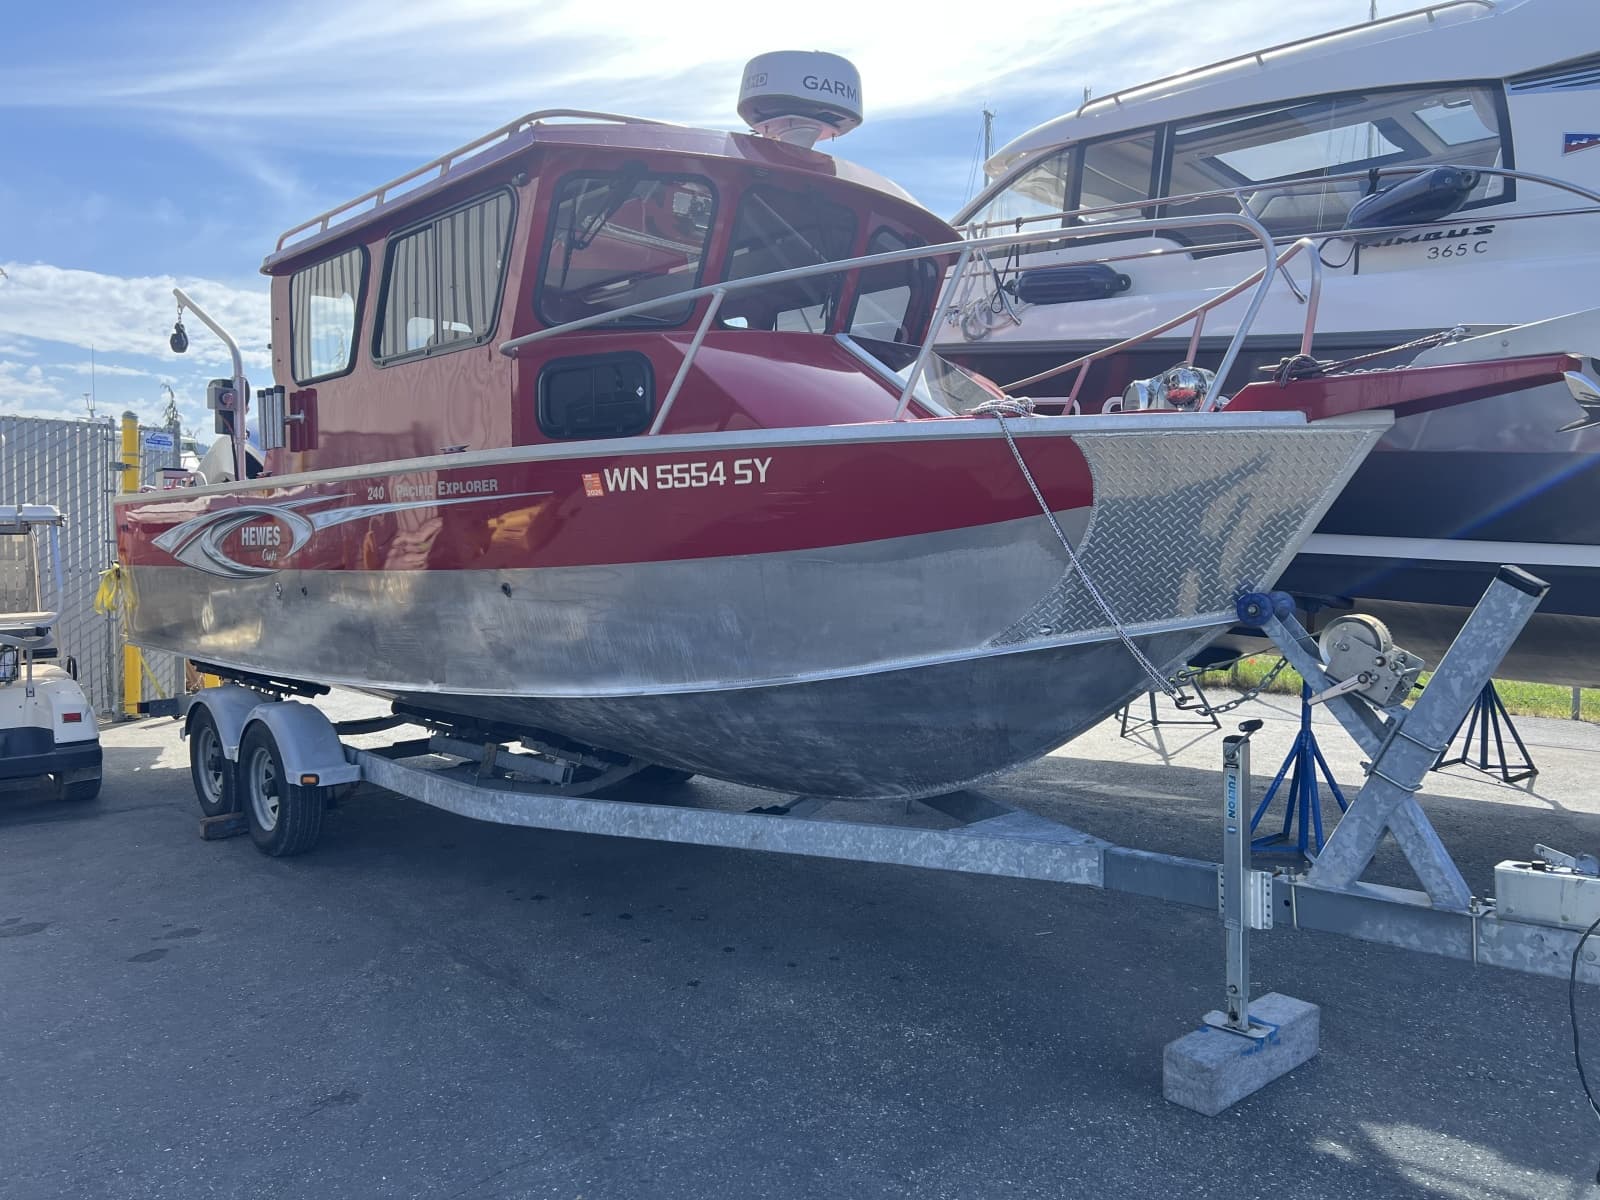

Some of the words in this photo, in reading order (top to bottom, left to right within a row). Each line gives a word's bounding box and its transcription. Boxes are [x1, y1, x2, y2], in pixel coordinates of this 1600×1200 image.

[1427, 243, 1468, 260] 365
[1474, 240, 1488, 254] C
[603, 466, 649, 492] WN
[656, 460, 727, 490] 5554
[734, 457, 773, 485] SY
[367, 486, 385, 500] 240
[396, 484, 434, 497] PACIFIC
[241, 526, 281, 546] HEWES
[1227, 774, 1237, 819] FULTON
